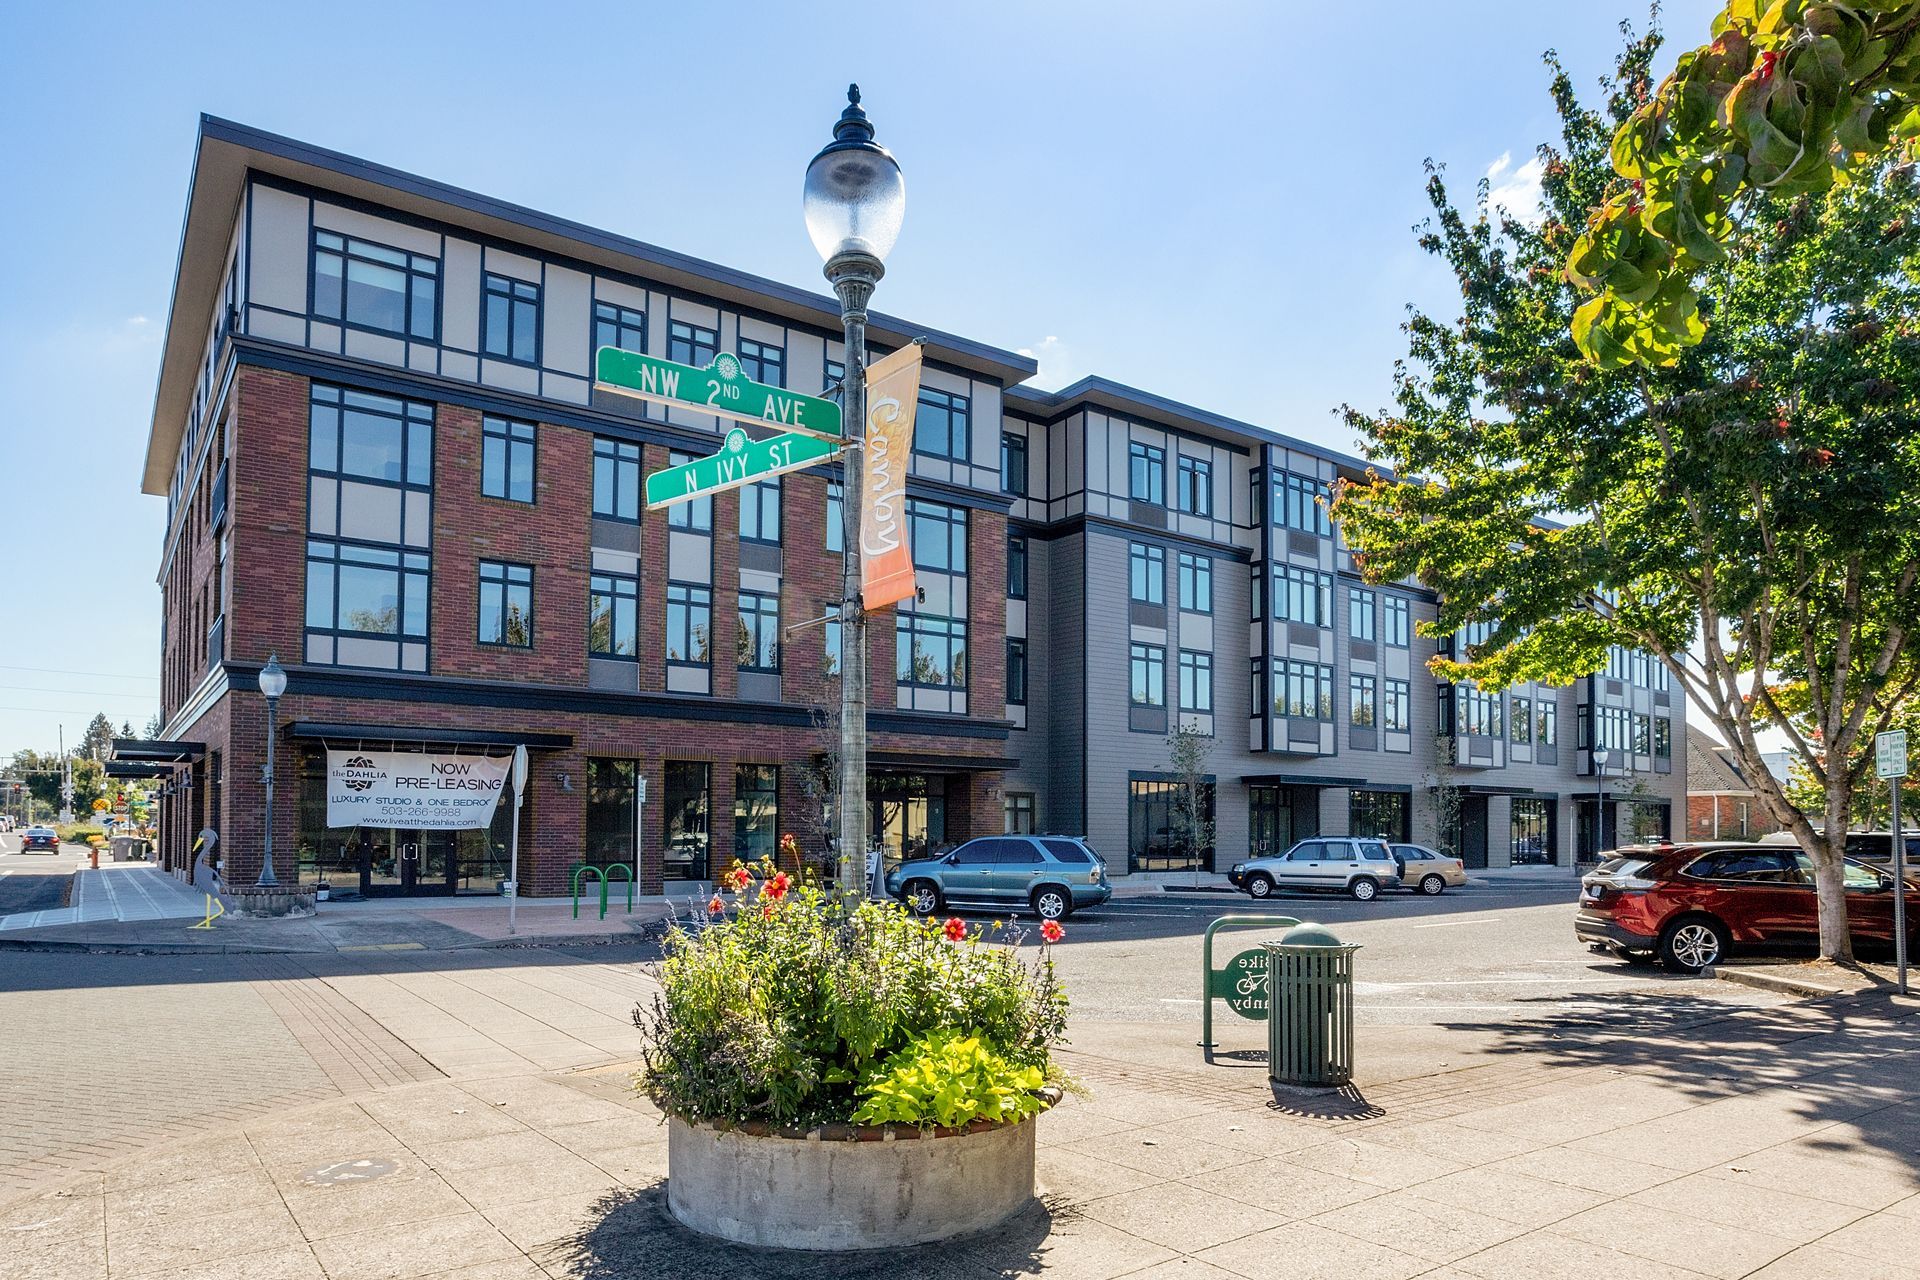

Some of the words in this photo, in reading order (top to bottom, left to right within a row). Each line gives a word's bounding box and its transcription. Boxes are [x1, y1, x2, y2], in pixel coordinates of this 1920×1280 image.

[641, 363, 680, 399] NW
[706, 380, 740, 409] 2ND
[763, 393, 806, 428] AVE
[685, 468, 698, 495] N
[716, 454, 748, 486] IVY
[769, 440, 793, 470] ST
[863, 396, 905, 556] Canby
[431, 763, 471, 775] NOW
[395, 776, 502, 791] PRE-LEASING
[332, 795, 371, 804] LUXURY
[375, 796, 412, 805] STUDIO
[415, 798, 422, 806] &
[428, 798, 449, 806] ONE
[381, 806, 461, 817] 503-266-9988
[362, 816, 477, 826] www.liveatthedahlia.com
